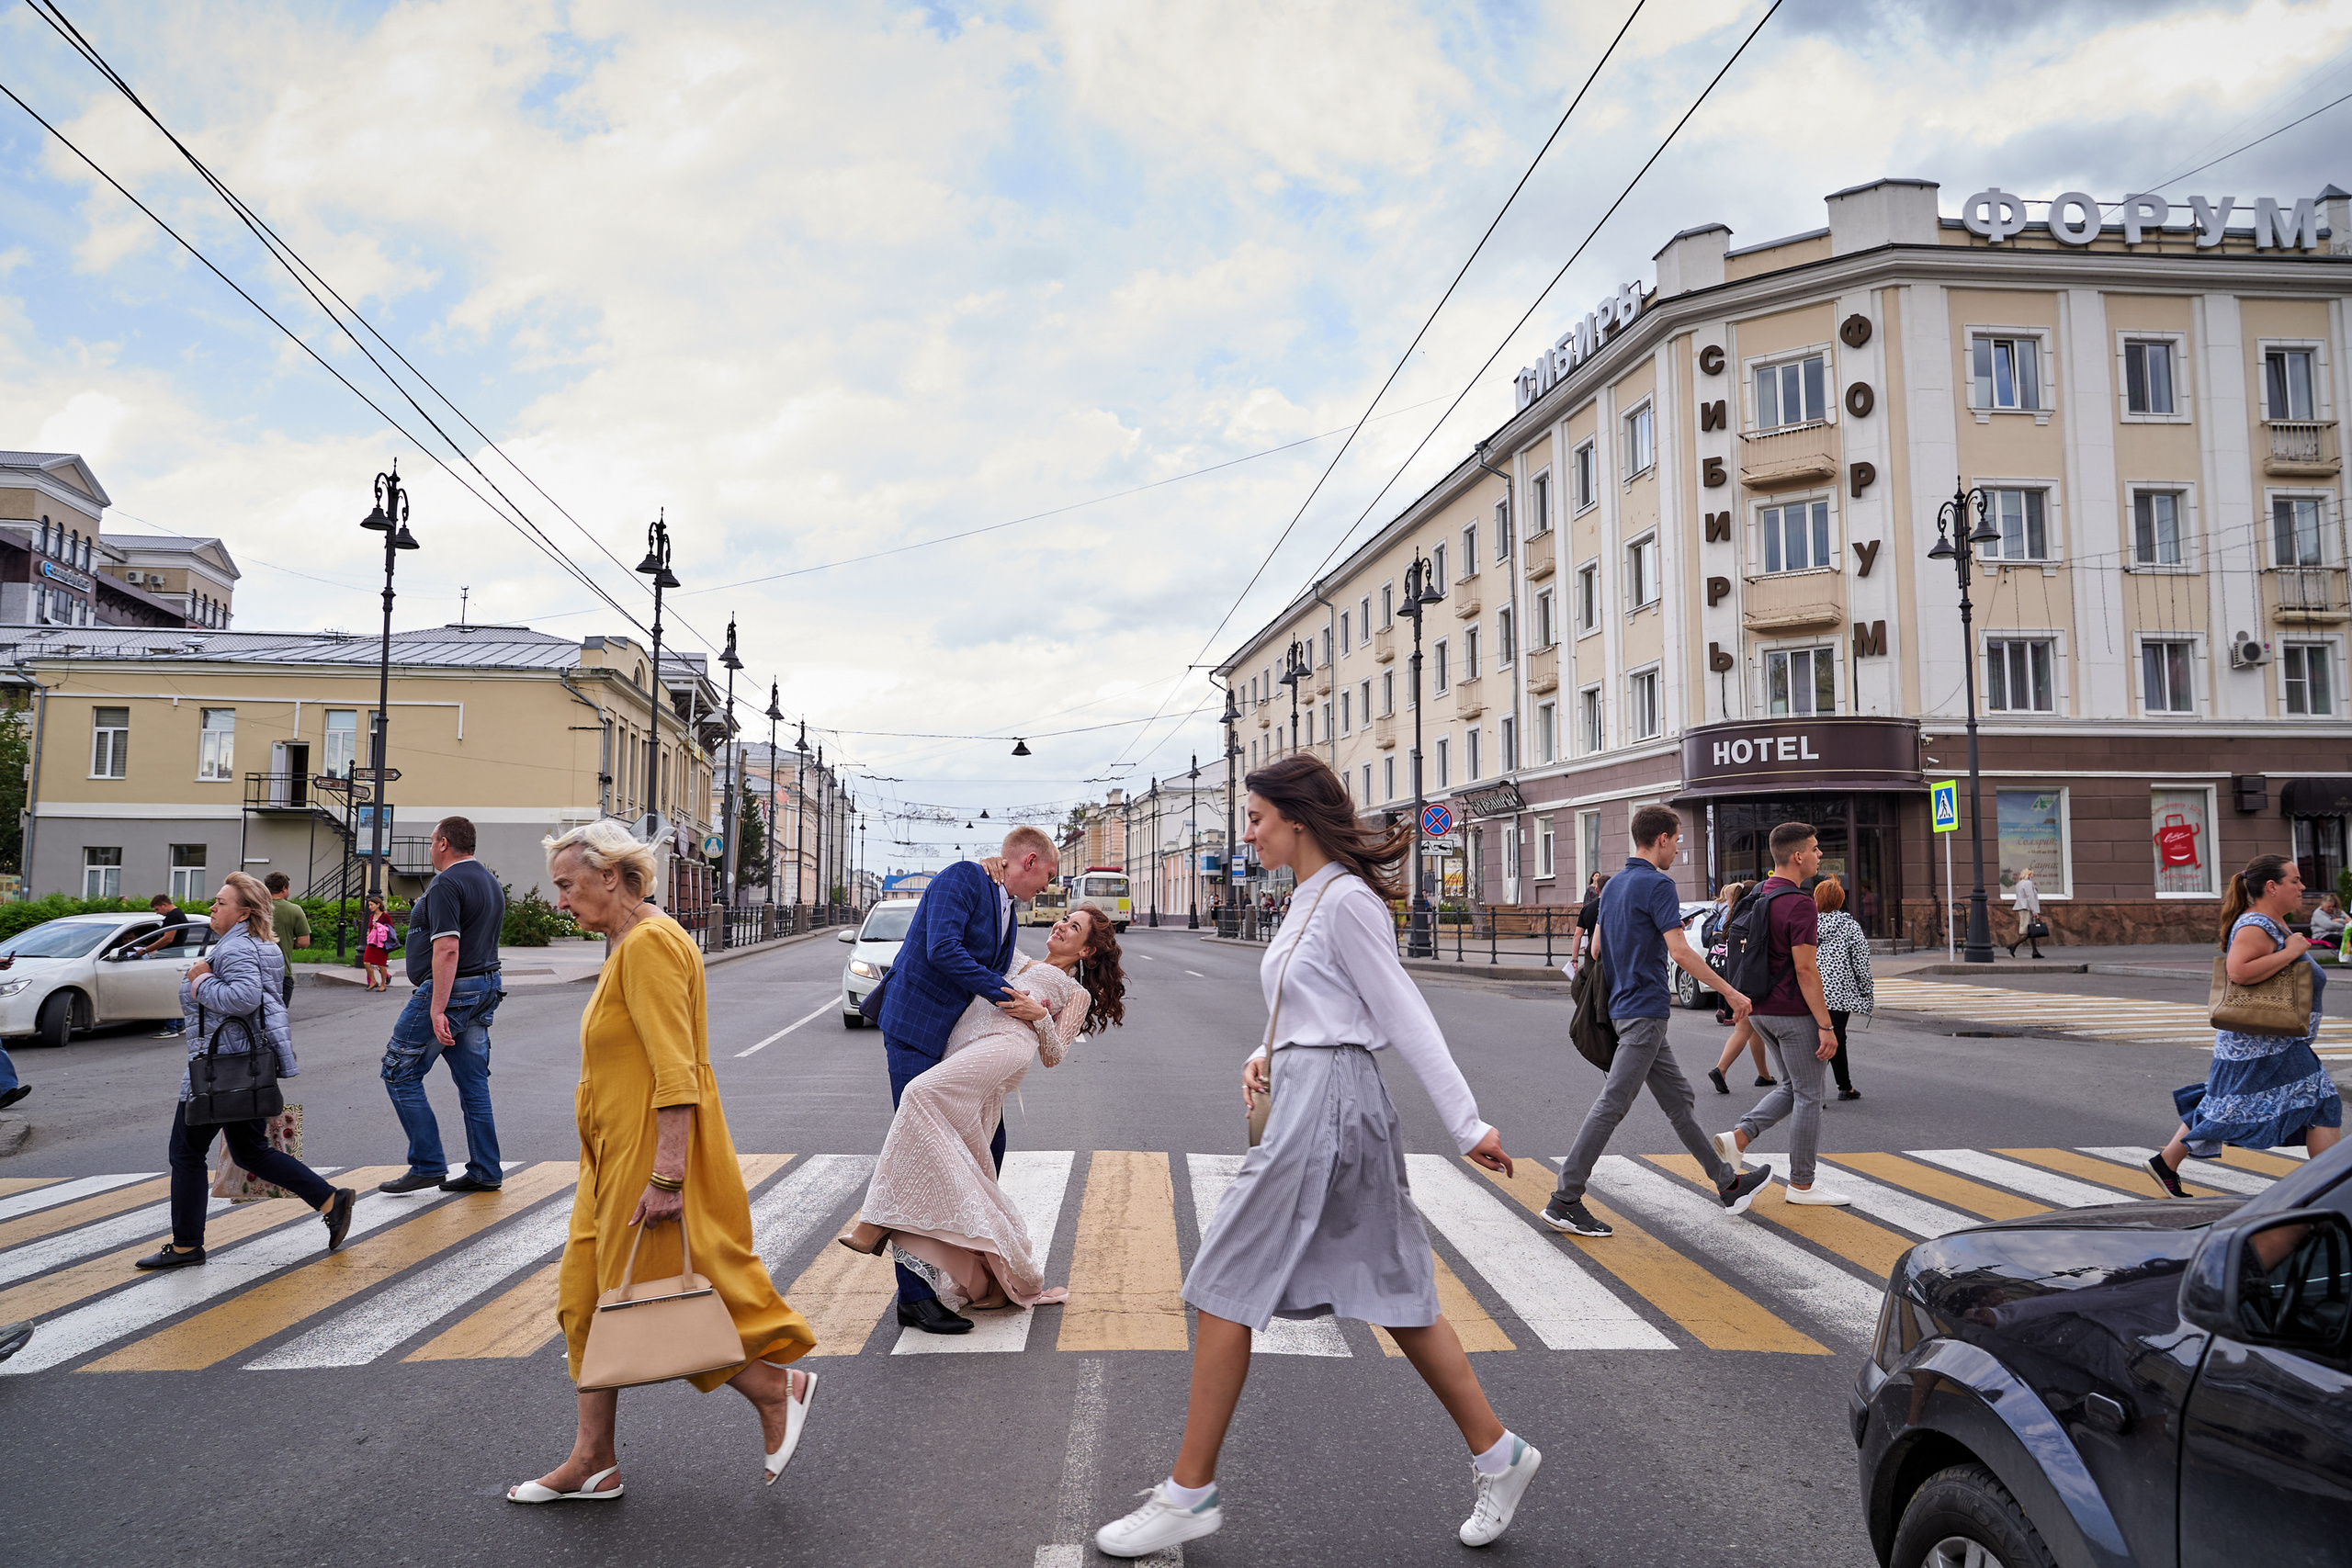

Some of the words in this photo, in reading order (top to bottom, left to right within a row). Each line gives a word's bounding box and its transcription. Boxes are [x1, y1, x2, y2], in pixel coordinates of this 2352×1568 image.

[1962, 187, 2317, 250] ФОРУМ
[1519, 283, 1642, 411] СИБИРЬ
[1700, 344, 1734, 672] СИБИРЬ
[1840, 313, 1887, 658] ФОРУМ
[1713, 736, 1819, 765] HOTEL
[2030, 860, 2058, 874] Сауна:
